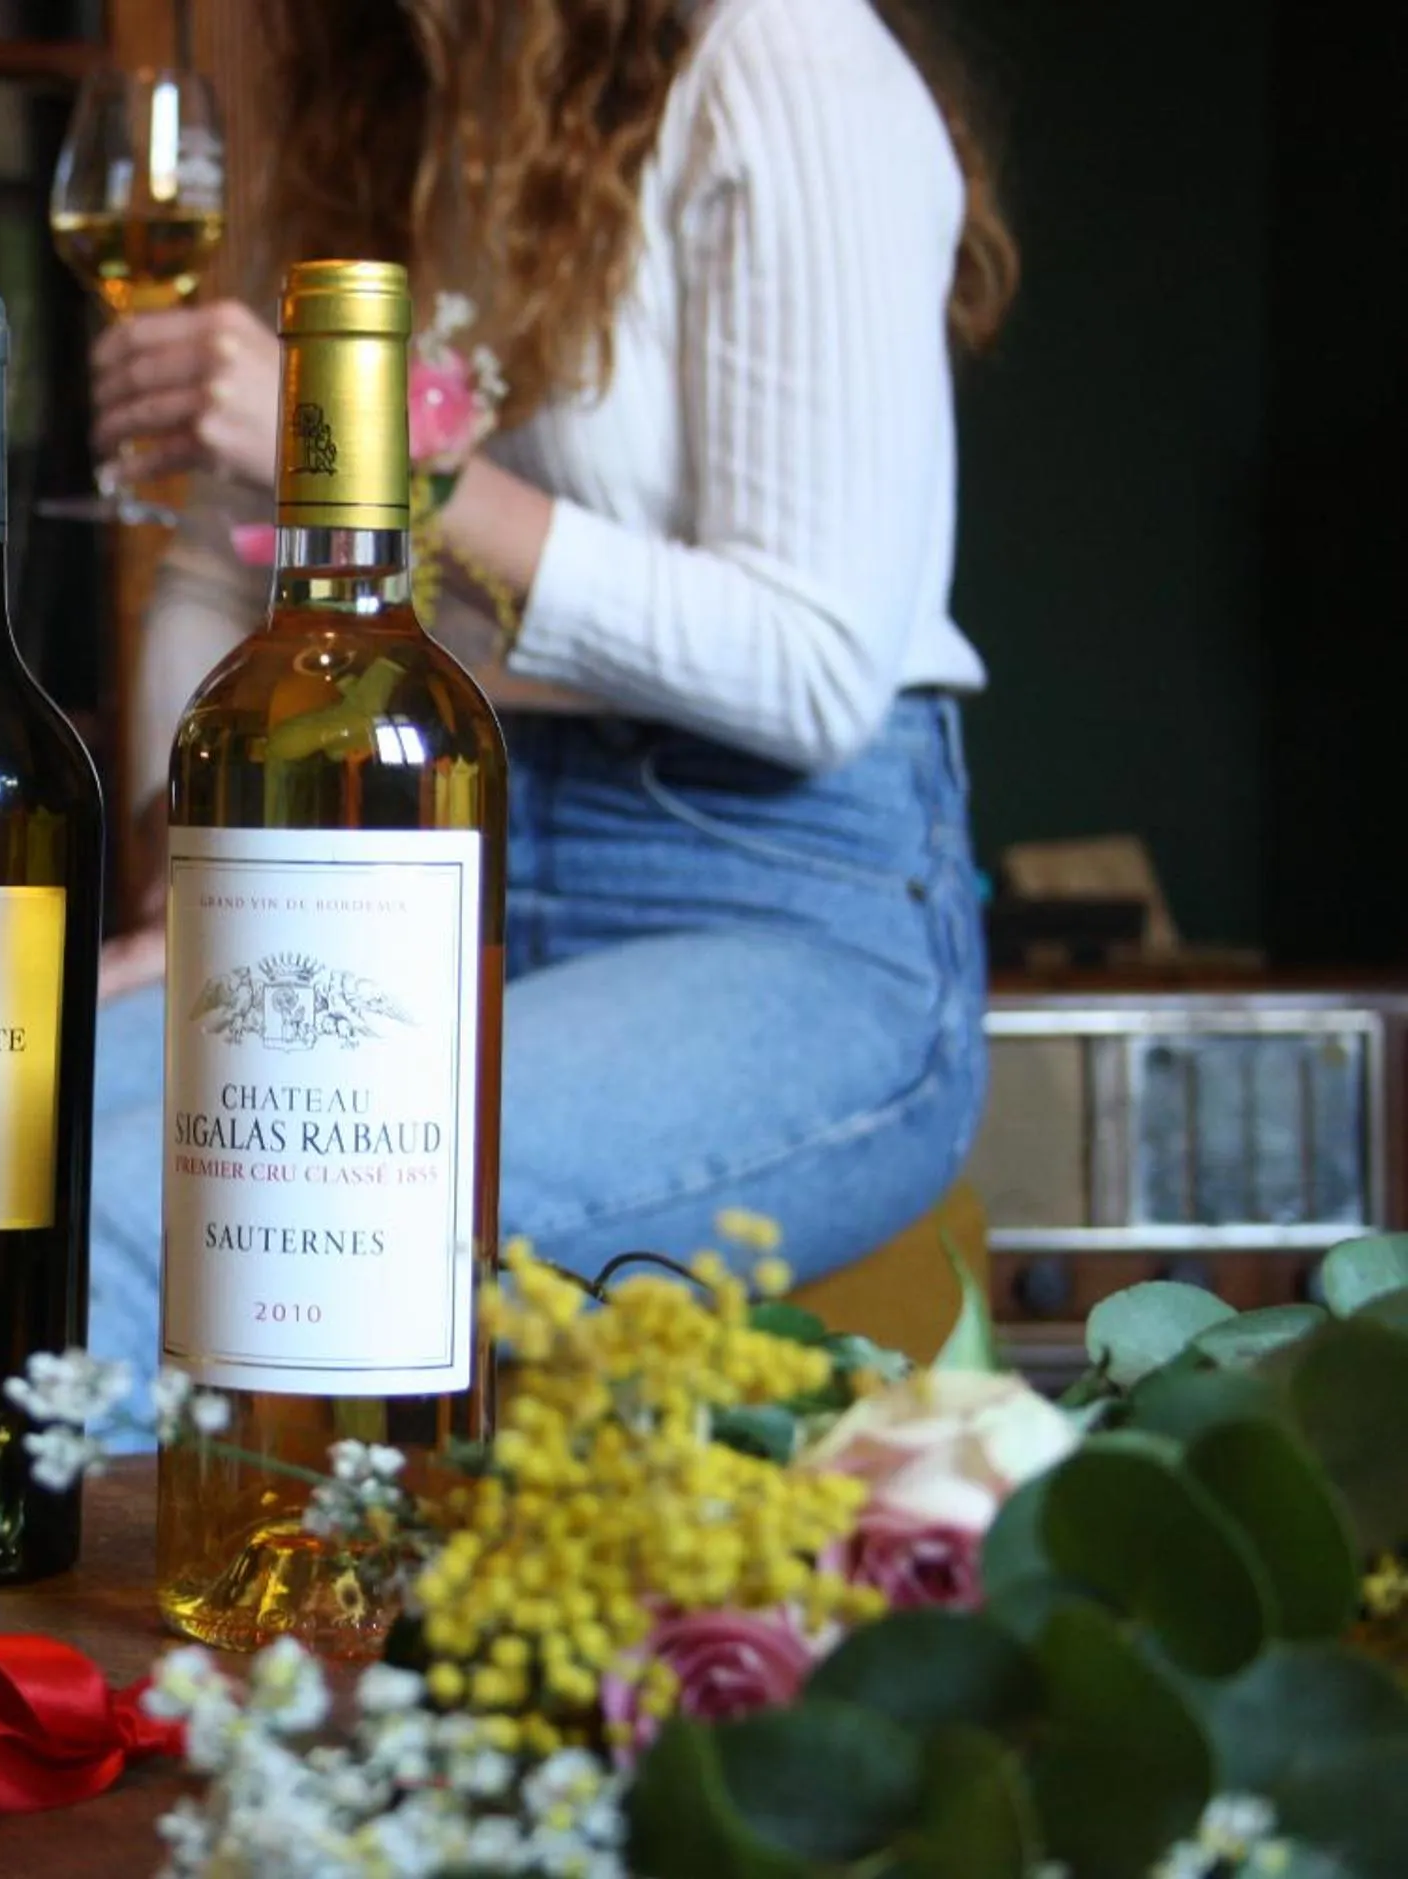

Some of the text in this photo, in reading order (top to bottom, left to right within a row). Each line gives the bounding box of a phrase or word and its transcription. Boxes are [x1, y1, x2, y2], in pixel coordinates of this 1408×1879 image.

[250, 895, 278, 911] VIN
[221, 1082, 373, 1114] CHATEAU
[174, 1111, 442, 1155] SIGALAS RABAUD
[174, 1154, 244, 1179] PREMIER
[250, 1161, 297, 1182] CRU
[396, 1166, 439, 1185] 1855
[205, 1221, 386, 1256] SAUTERNES
[253, 1301, 322, 1323] 2010
